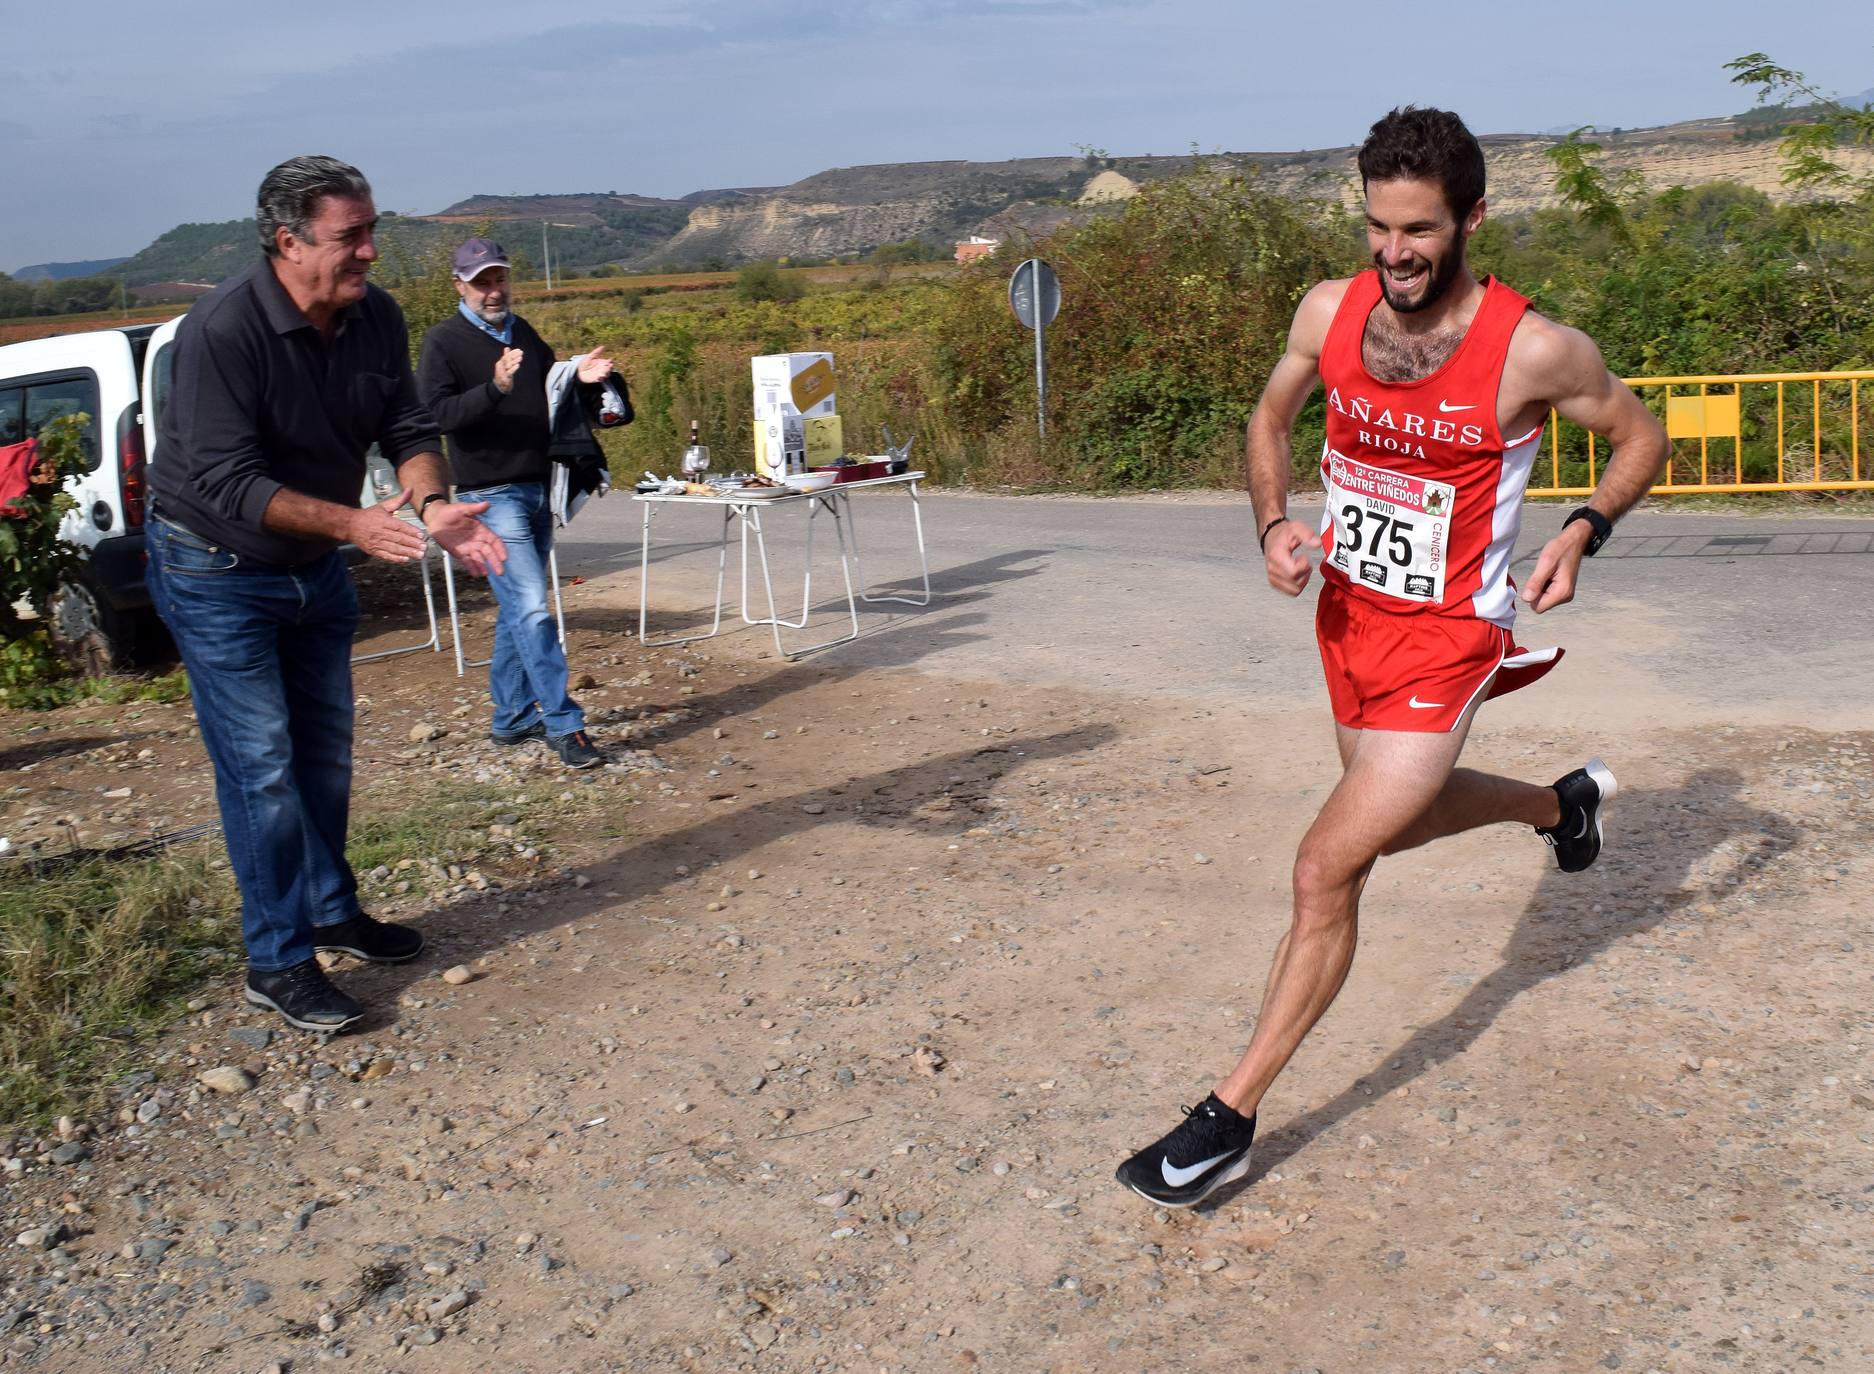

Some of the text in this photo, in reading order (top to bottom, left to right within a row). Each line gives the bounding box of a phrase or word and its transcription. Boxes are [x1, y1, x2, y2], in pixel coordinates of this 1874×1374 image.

[1329, 387, 1483, 446] AÑARES
[1358, 430, 1426, 459] RIOJA
[1345, 473, 1420, 506] ENTRE VIÑEDOS
[1368, 471, 1410, 489] CARRERA
[1366, 498, 1396, 515] DAVID
[1341, 504, 1414, 567] 375
[1430, 522, 1443, 572] CENICERO
